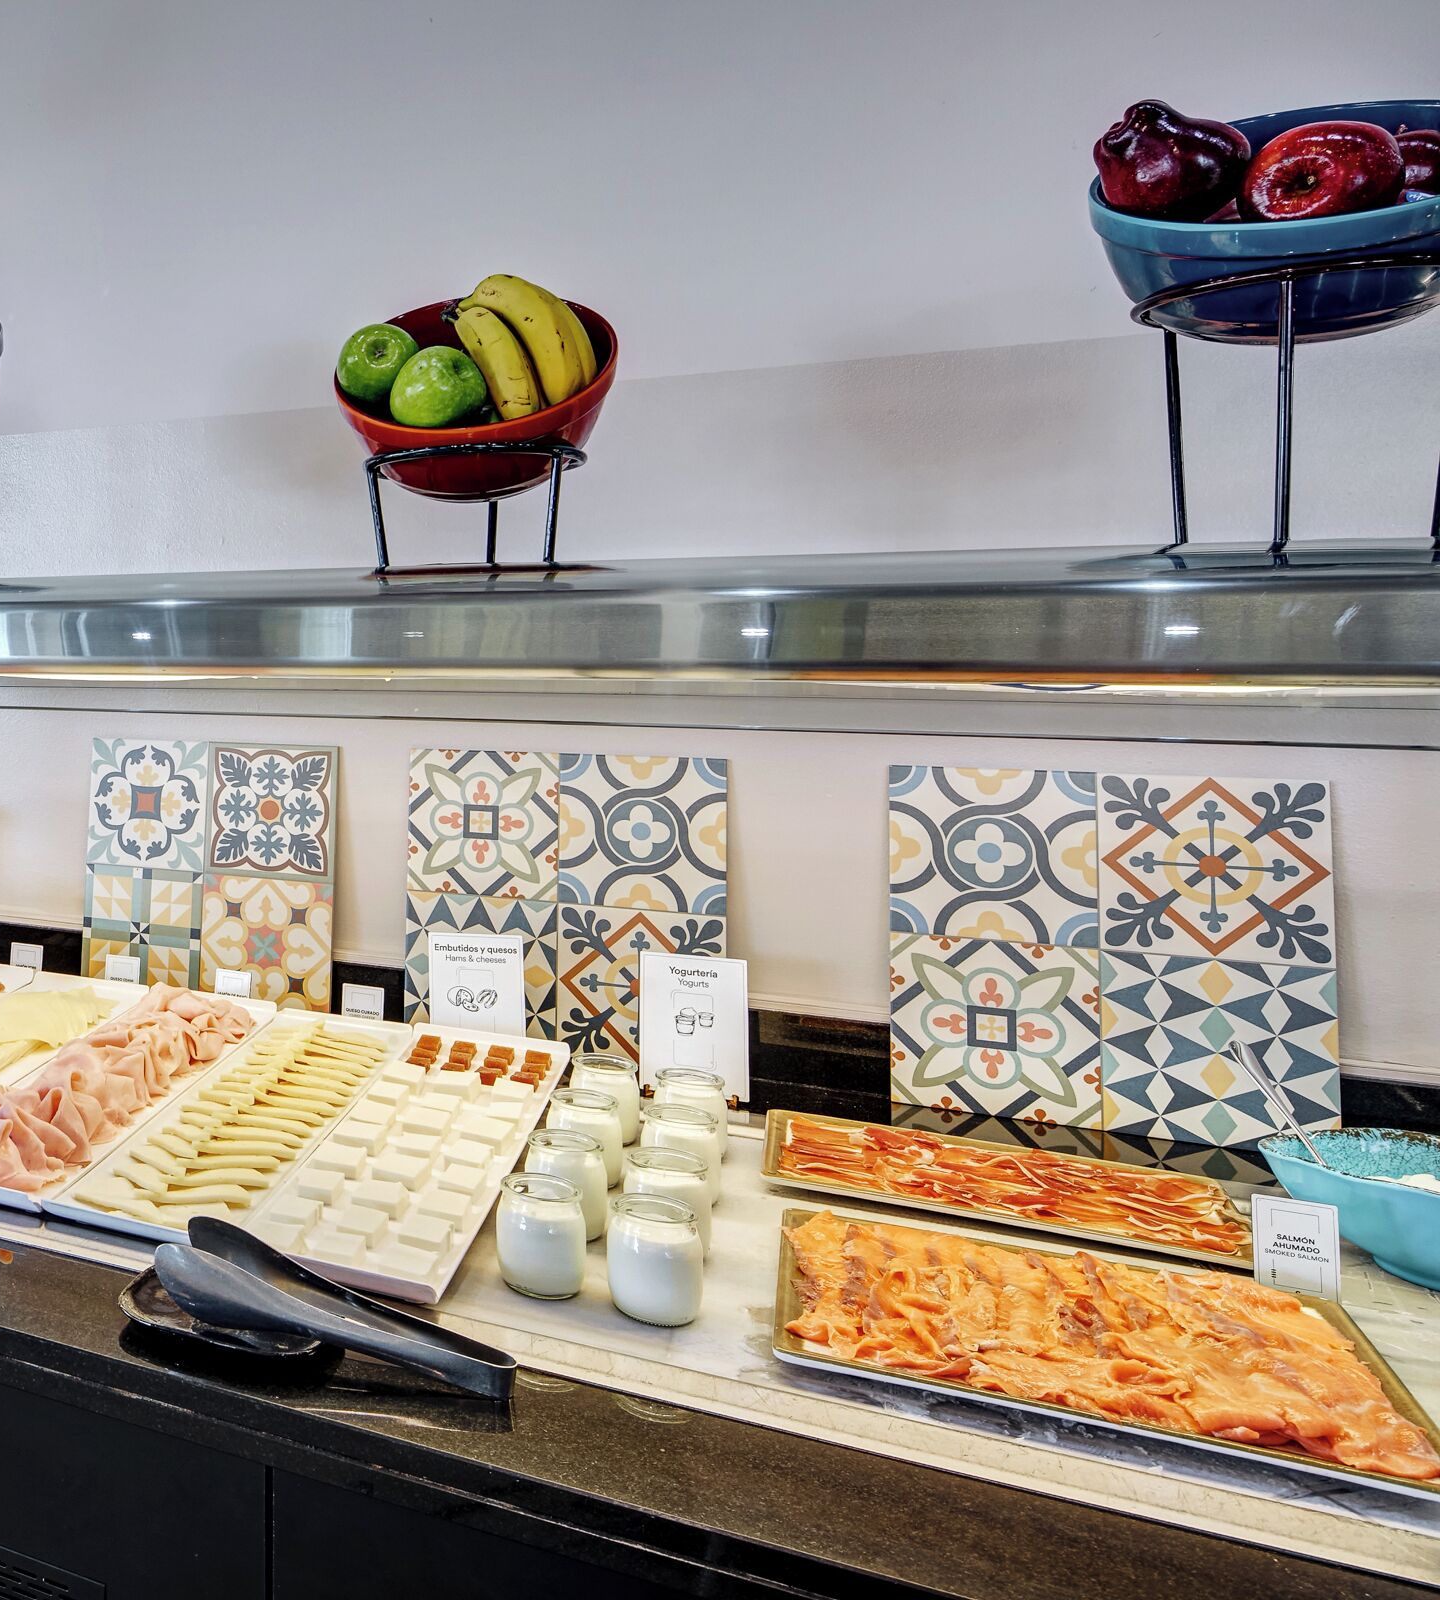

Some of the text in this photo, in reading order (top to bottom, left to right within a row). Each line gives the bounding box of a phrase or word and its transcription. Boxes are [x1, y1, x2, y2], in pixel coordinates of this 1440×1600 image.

[434, 943, 479, 953] Embutidos
[487, 946, 518, 955] quesos
[445, 954, 507, 964] Hams & cheeses
[669, 966, 718, 979] Yogurtería
[677, 977, 710, 988] Yogurts
[1276, 1233, 1315, 1246] SALMÓN
[1272, 1241, 1320, 1255] AHUMADO
[1264, 1248, 1330, 1263] SMOKED SALMON
